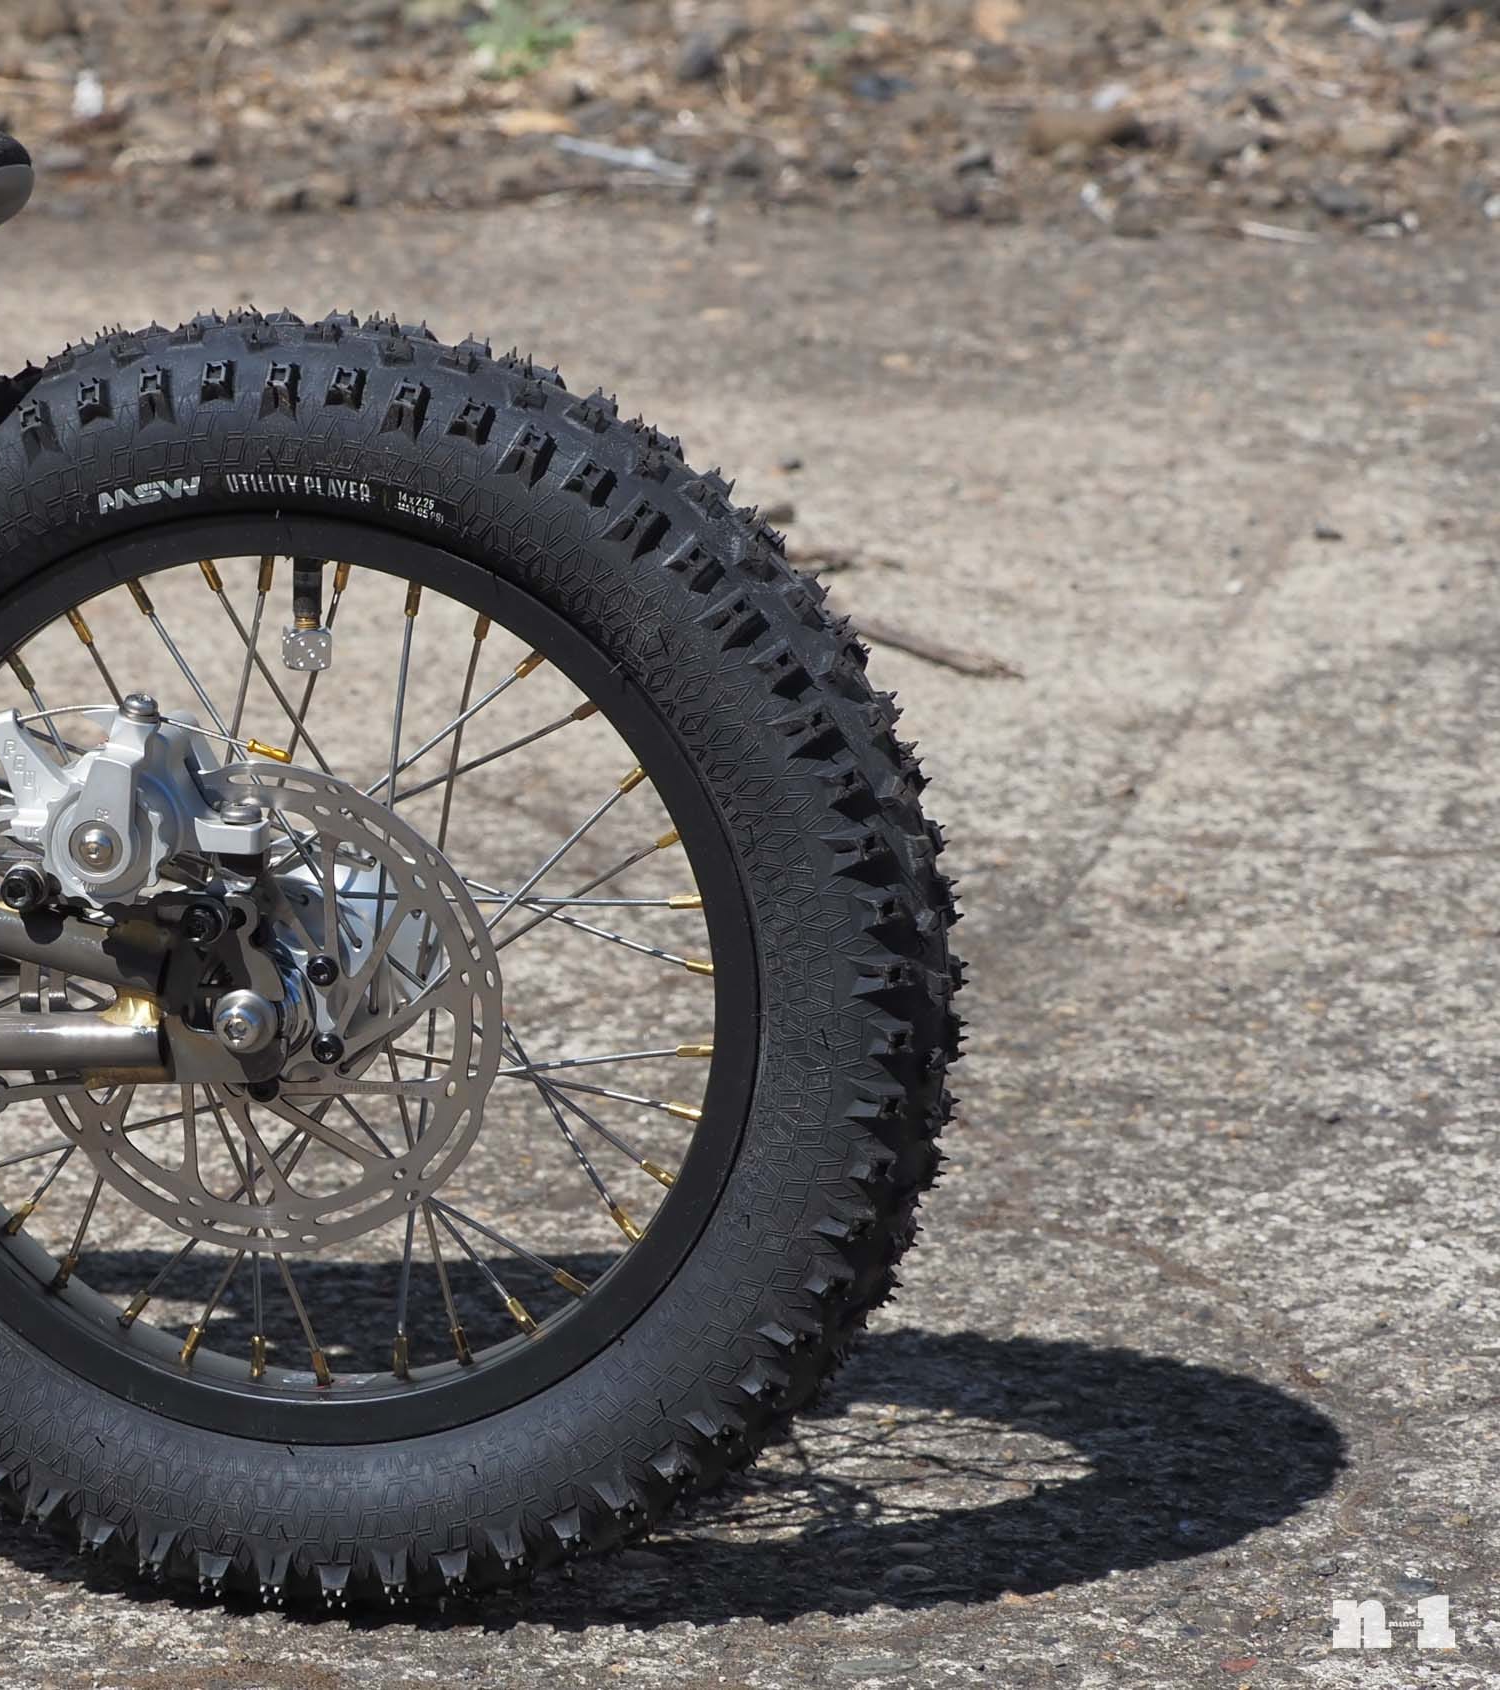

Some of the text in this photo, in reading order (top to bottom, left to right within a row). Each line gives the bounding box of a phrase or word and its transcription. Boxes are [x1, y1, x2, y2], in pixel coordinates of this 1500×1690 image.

[98, 473, 371, 515] MSW UTILITY PLAYER
[398, 491, 407, 502] 14
